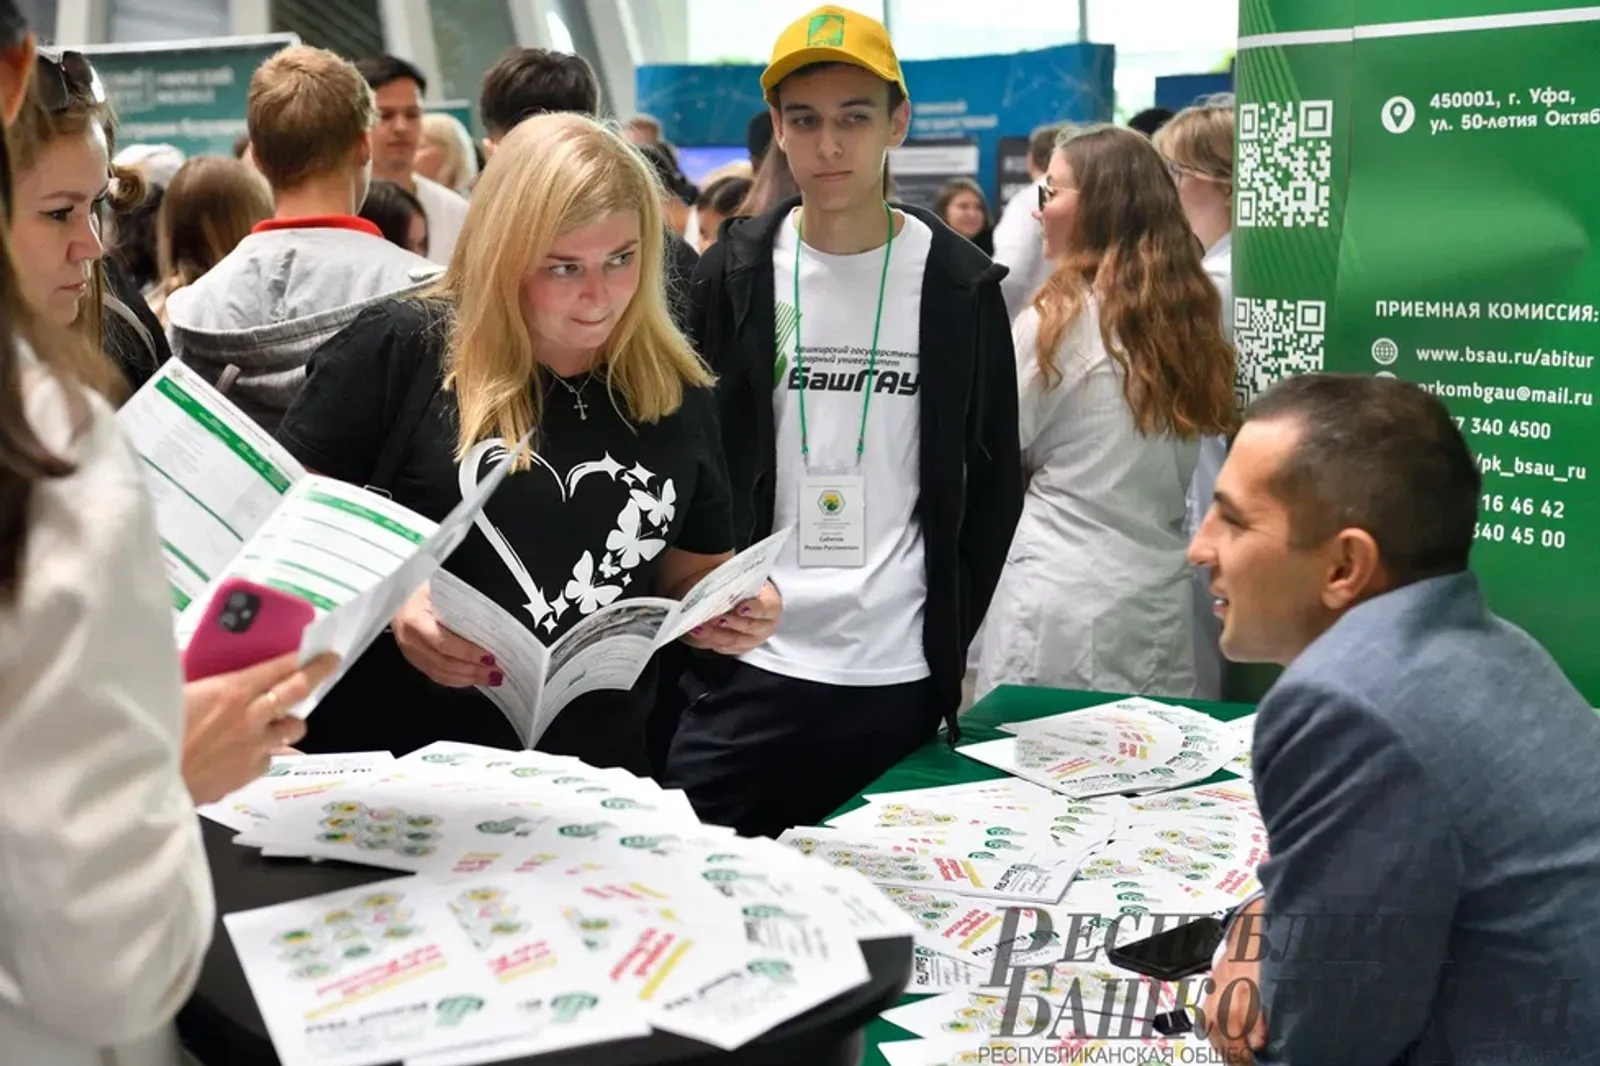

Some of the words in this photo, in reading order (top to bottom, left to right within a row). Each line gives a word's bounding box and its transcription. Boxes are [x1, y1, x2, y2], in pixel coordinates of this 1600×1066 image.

[1429, 90, 1500, 109] 450001,
[1508, 92, 1521, 105] г.
[1529, 86, 1576, 108] Уфа,
[1429, 118, 1453, 135] ул.
[1461, 113, 1538, 130] 50-летия
[1545, 108, 1600, 126] Октяб
[1375, 300, 1480, 319] ПРИЕМНАЯ
[1488, 302, 1599, 322] КОМИССИЯ:
[792, 354, 837, 364] арарный
[837, 356, 900, 367] универитет
[794, 345, 848, 354] Бшкирский
[1416, 346, 1595, 368] www.bsau.ru/abitur
[788, 366, 921, 396] БашГАУ
[1471, 417, 1503, 436] 340
[1509, 419, 1552, 440] 4500
[1510, 497, 1534, 516] 46
[1541, 500, 1565, 519] 42
[1511, 526, 1535, 545] 45
[1541, 529, 1566, 548] 00
